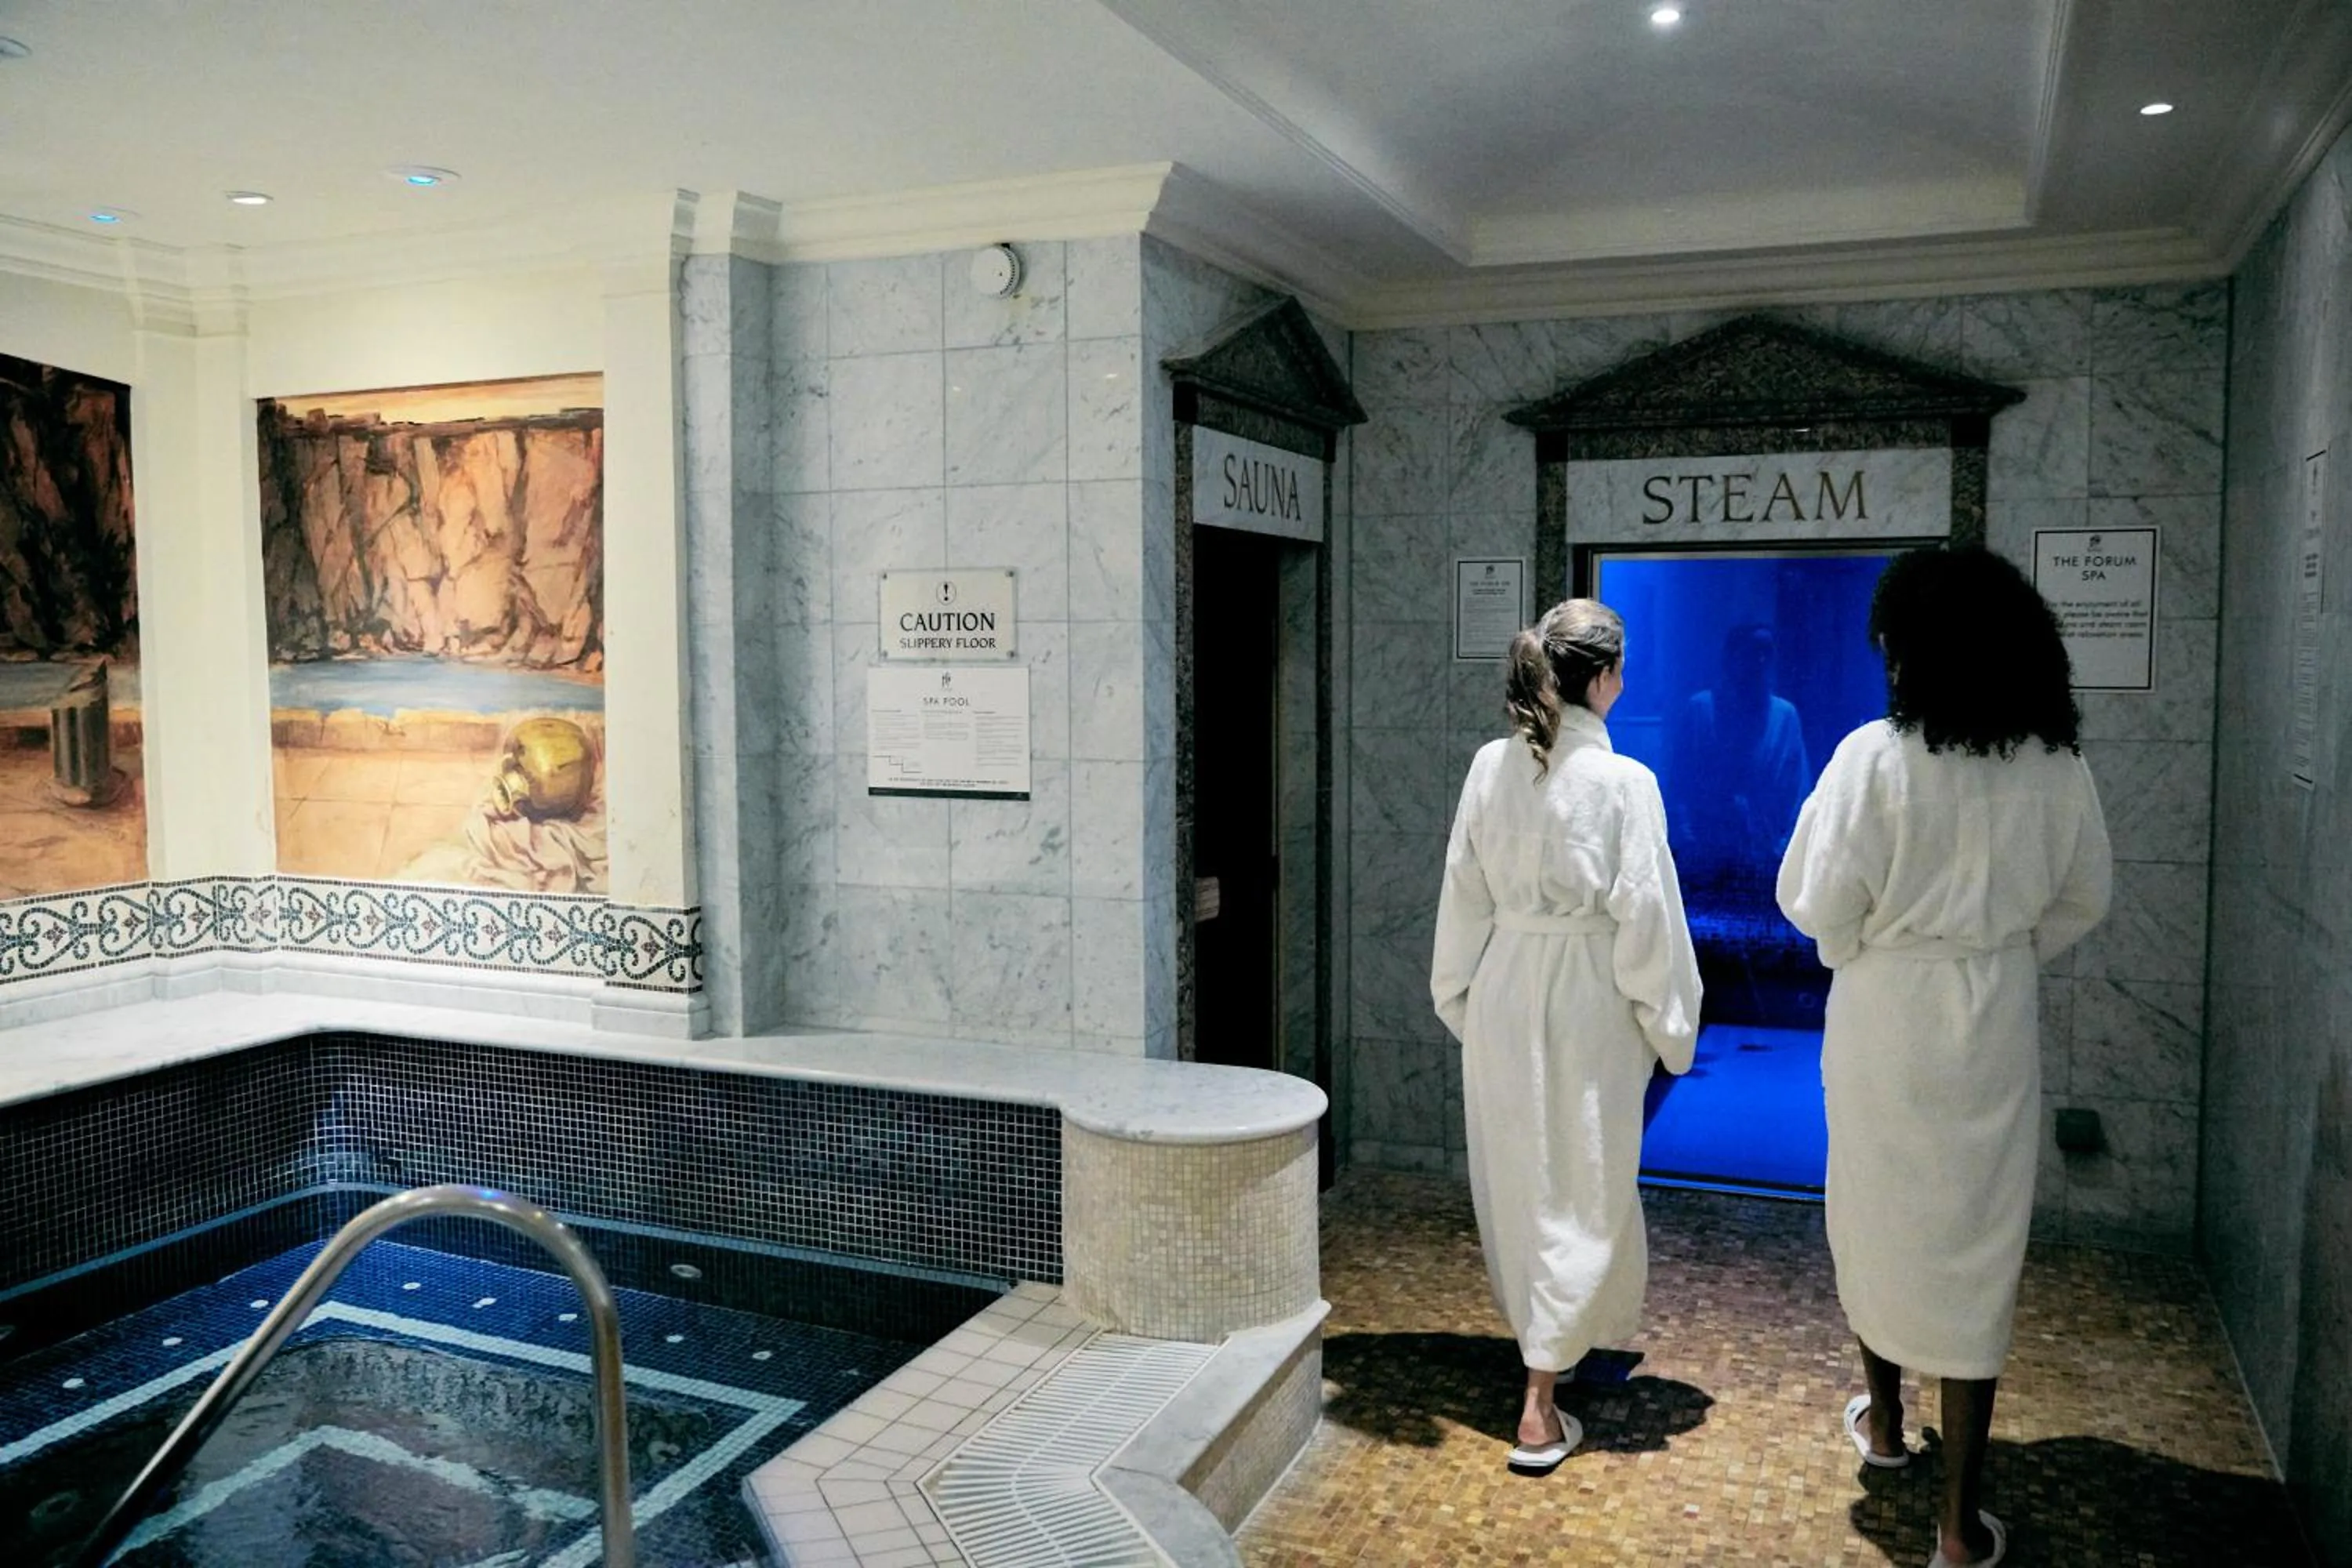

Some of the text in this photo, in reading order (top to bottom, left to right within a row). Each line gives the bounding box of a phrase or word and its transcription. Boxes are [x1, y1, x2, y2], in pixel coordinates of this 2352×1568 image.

[1224, 452, 1301, 522] SAUNA
[1642, 470, 1867, 524] STEAM
[2053, 556, 2136, 567] THE FORUM
[2082, 570, 2107, 581] SPA
[900, 612, 995, 631] CAUTION
[899, 637, 996, 649] SLIPPERY FLOOR
[923, 697, 970, 706] SPA POOL
